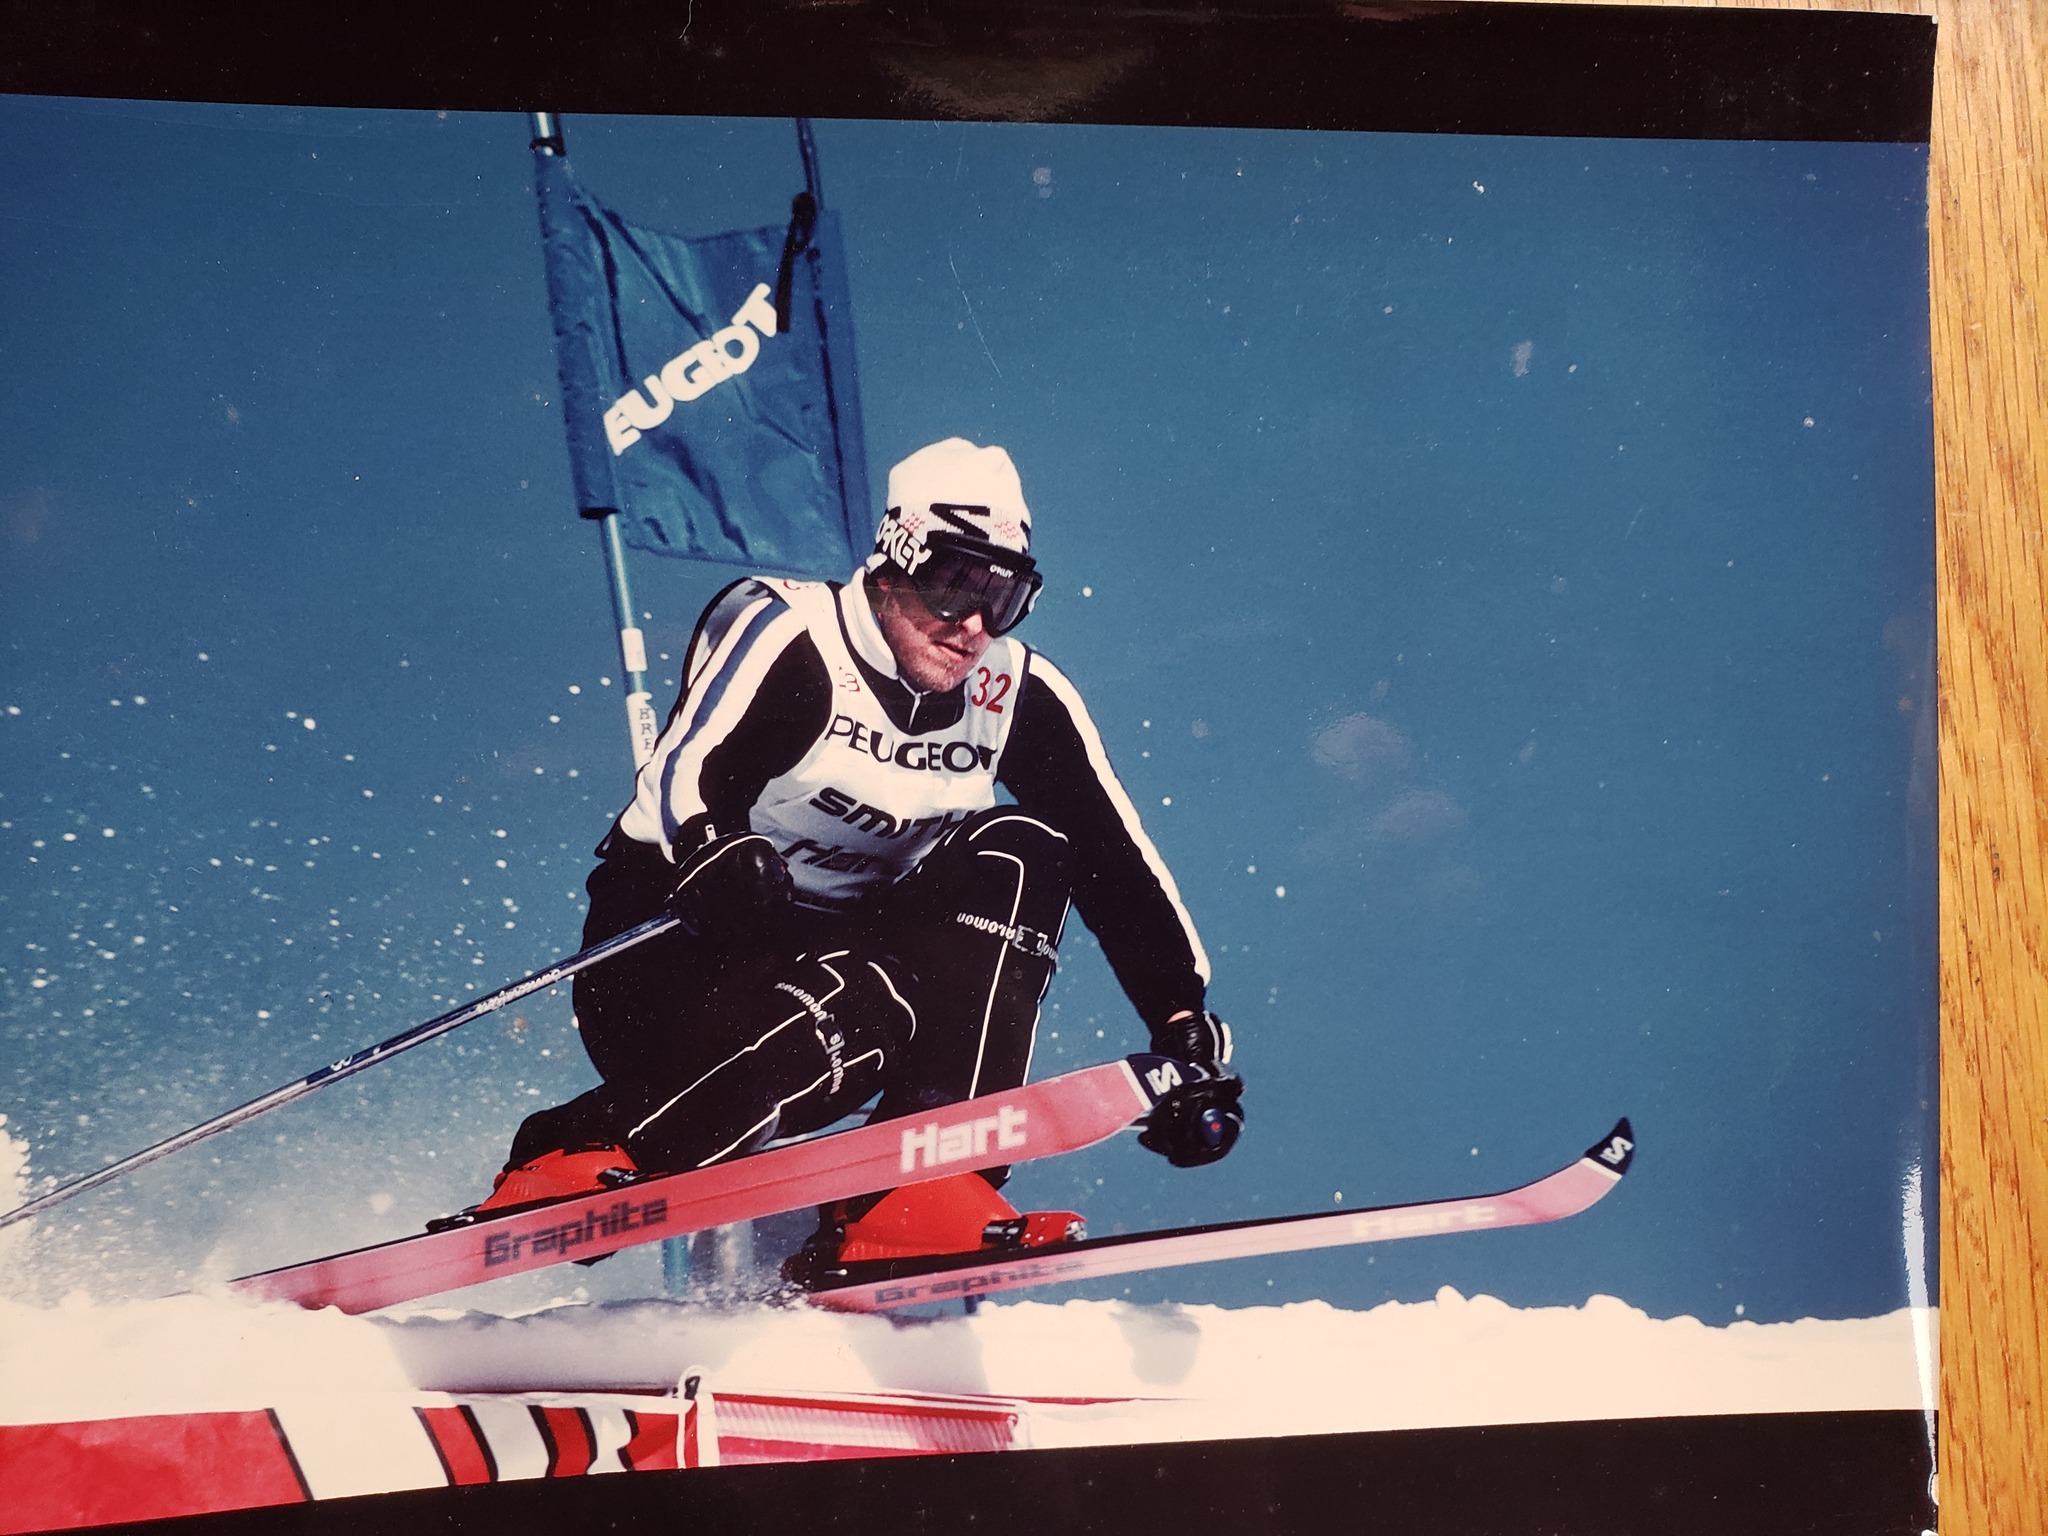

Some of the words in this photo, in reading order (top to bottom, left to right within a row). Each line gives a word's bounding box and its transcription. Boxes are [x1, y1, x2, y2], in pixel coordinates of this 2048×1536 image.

[603, 283, 778, 455] EUGEOT
[970, 666, 1012, 714] 32
[824, 713, 998, 773] PEUGEOT
[808, 787, 977, 840] SMITH
[900, 1104, 1028, 1174] Hart
[484, 1198, 668, 1268] Graphite
[1352, 1205, 1496, 1237] Hart
[875, 1261, 1084, 1304] Graphite
